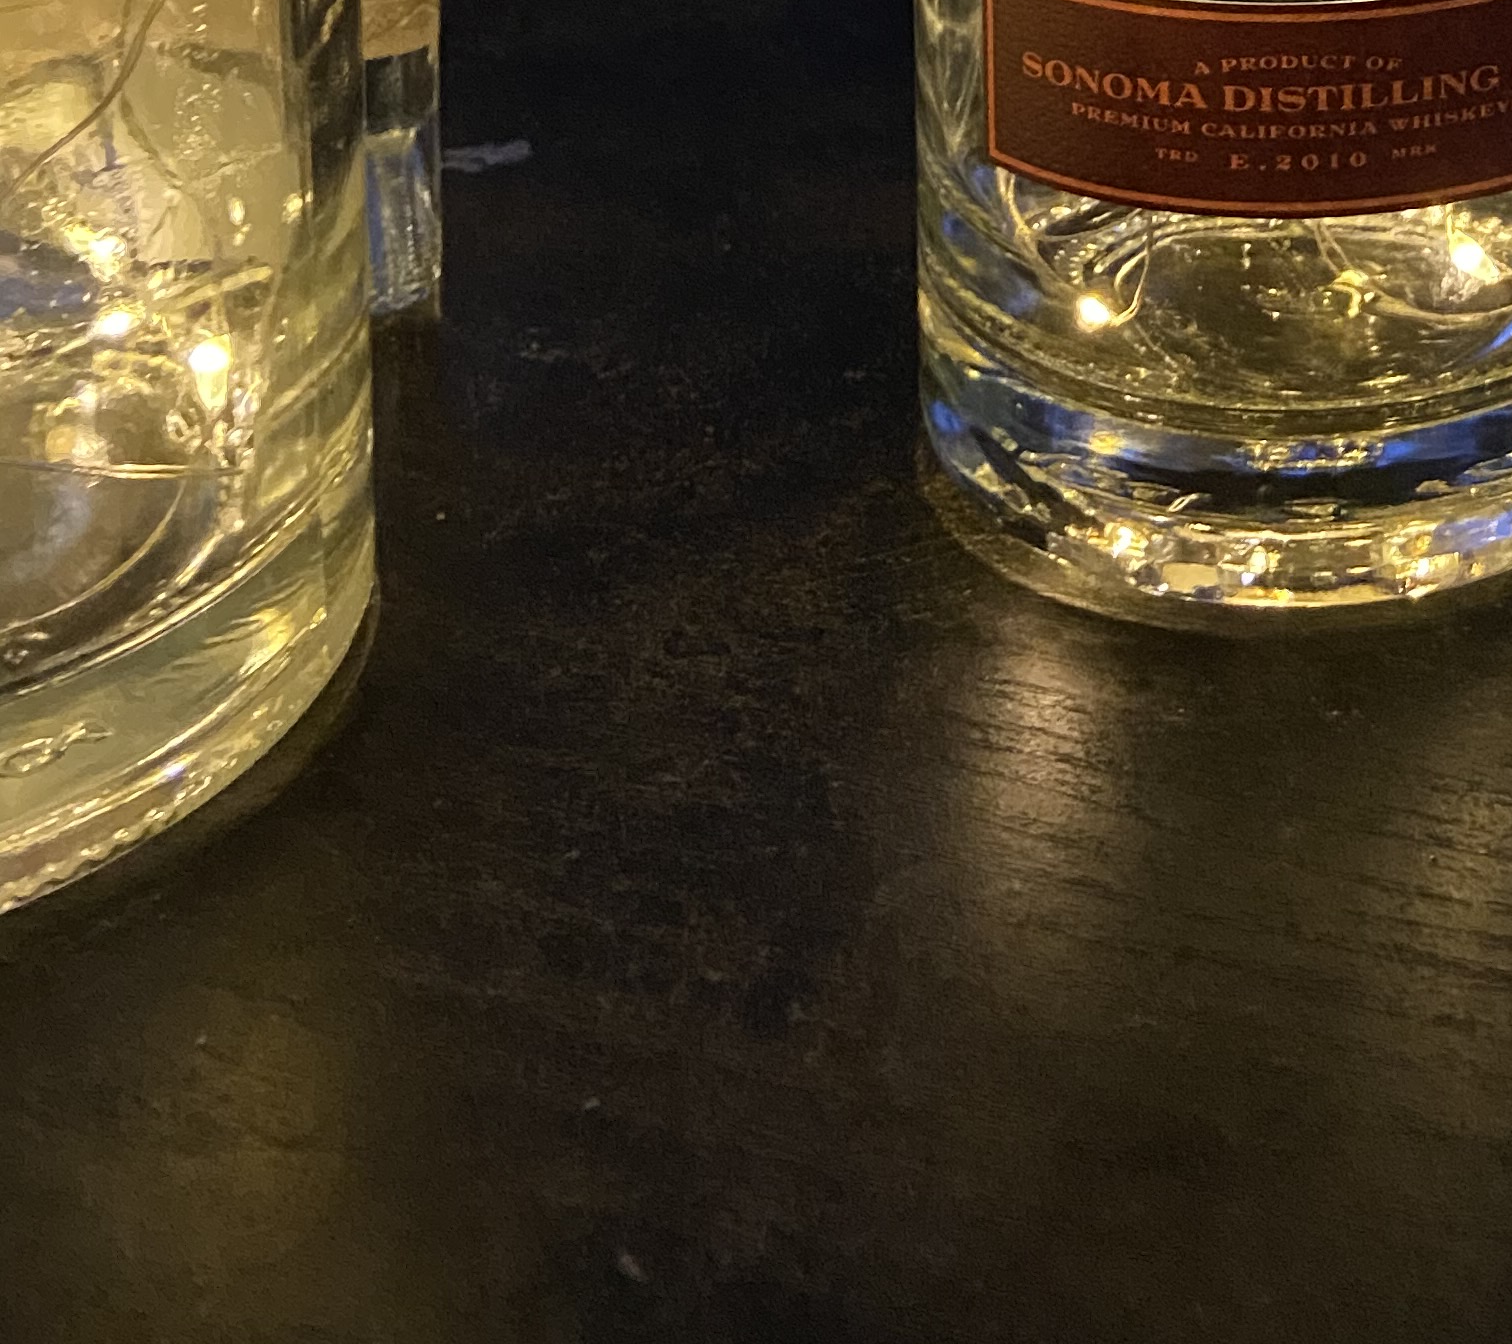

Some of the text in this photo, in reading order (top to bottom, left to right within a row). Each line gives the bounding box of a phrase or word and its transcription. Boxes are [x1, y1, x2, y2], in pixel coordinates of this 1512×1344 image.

[1021, 50, 1208, 110] SONOMA
[1222, 64, 1500, 112] DISTILLING
[1194, 54, 1403, 76] A PRODUCT OF
[1071, 101, 1191, 136] PREMIUM
[1200, 120, 1378, 140] CALIFORNIA
